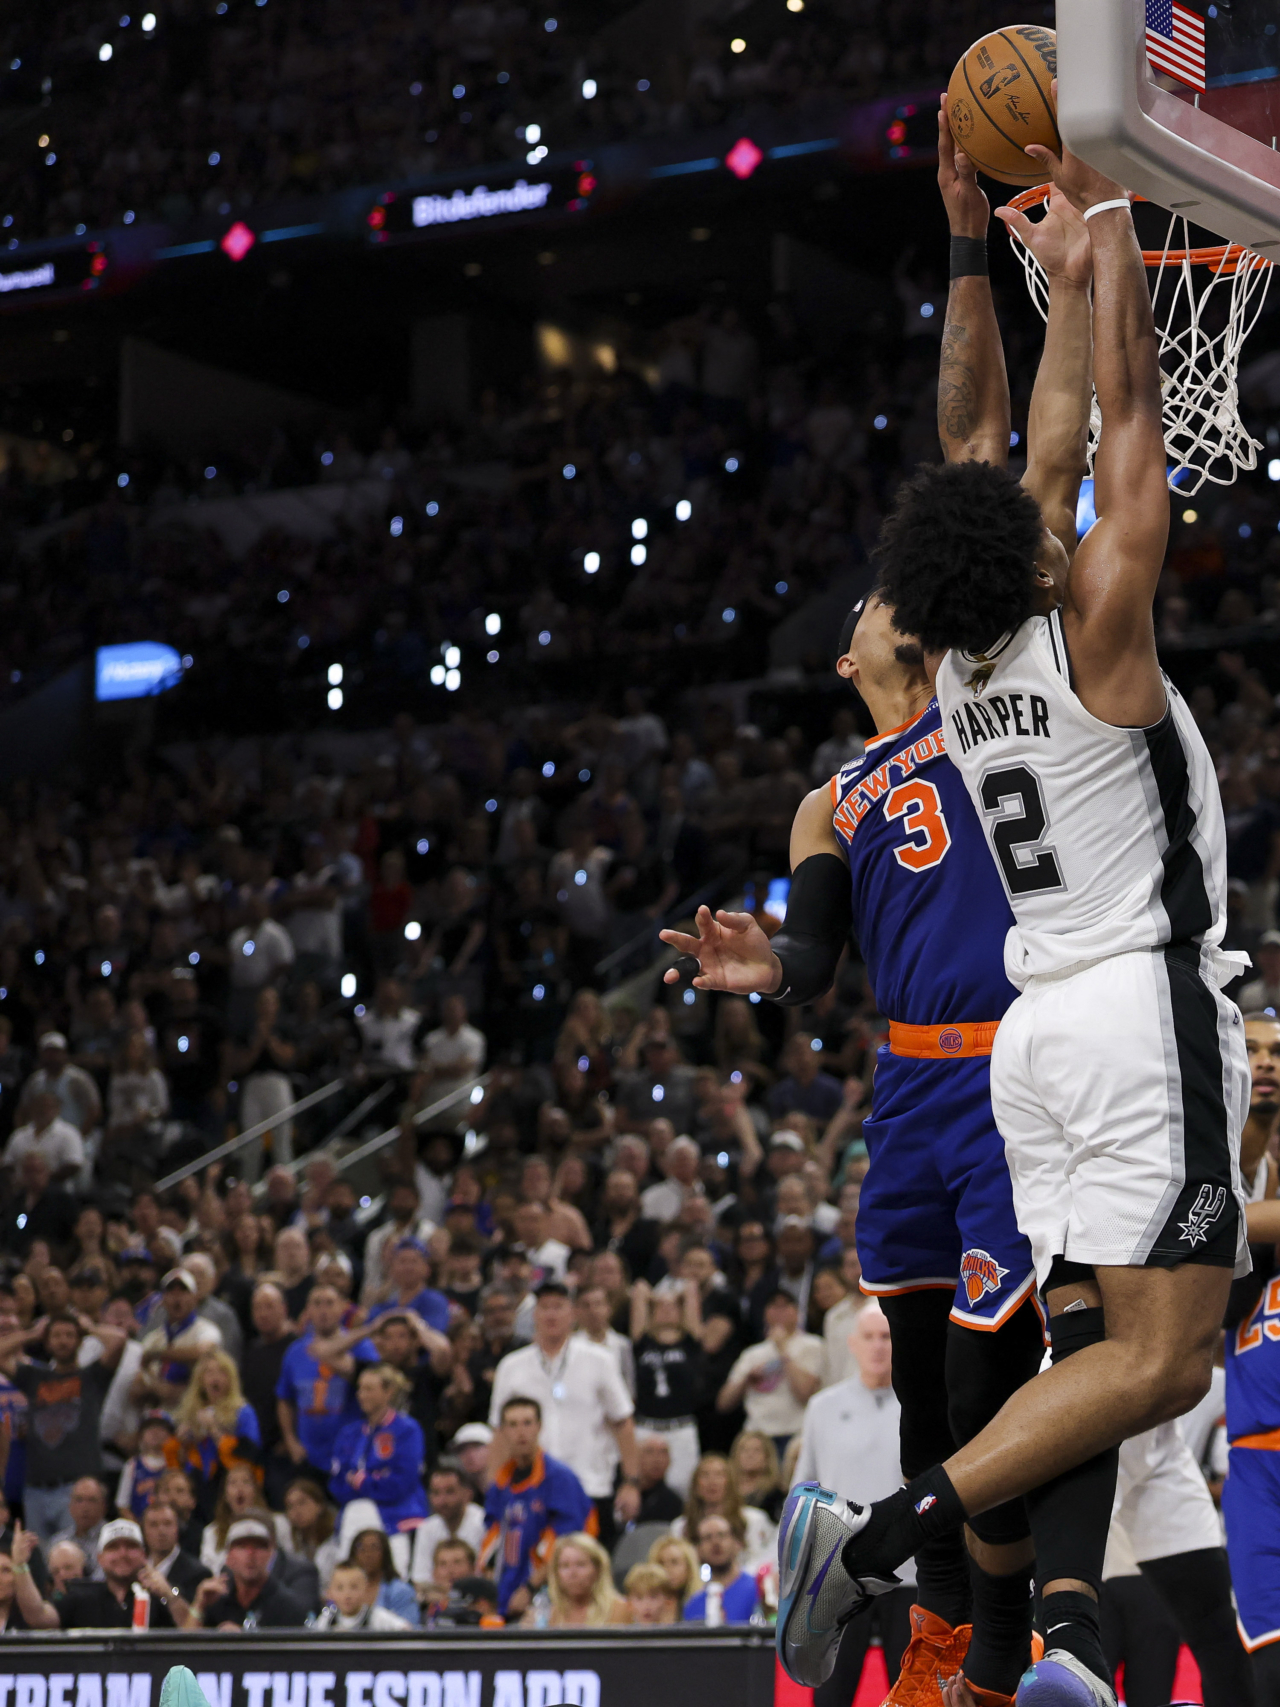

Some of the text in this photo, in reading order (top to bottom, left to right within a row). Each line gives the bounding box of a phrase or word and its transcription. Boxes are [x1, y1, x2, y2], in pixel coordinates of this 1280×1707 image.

[951, 693, 1051, 755] HARPER
[833, 763, 891, 846] NEW
[883, 777, 952, 873] 3
[977, 760, 1069, 901] 2
[961, 1253, 999, 1287] KNICKS
